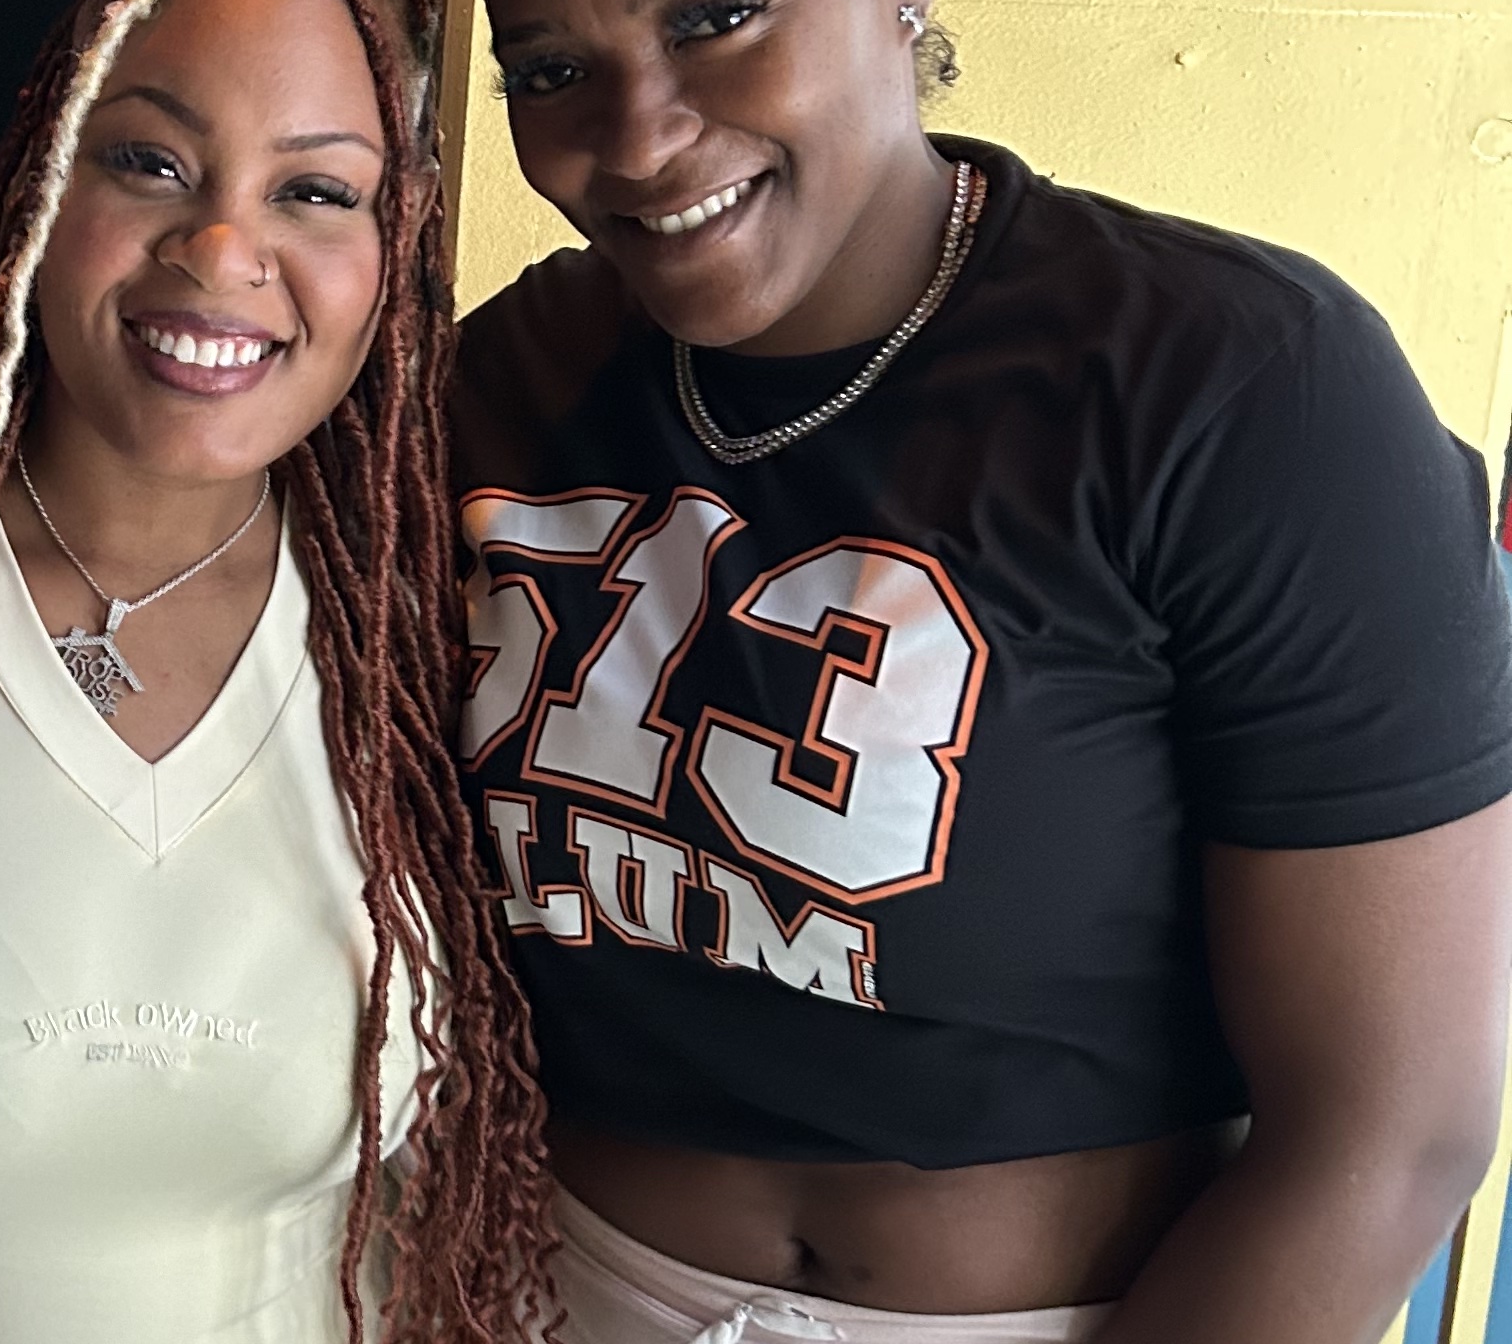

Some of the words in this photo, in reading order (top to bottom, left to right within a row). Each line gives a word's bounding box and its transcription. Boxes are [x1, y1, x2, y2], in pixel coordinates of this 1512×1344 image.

[66, 664, 125, 709] OUSE
[459, 485, 989, 905] 513
[483, 789, 886, 1012] LUM
